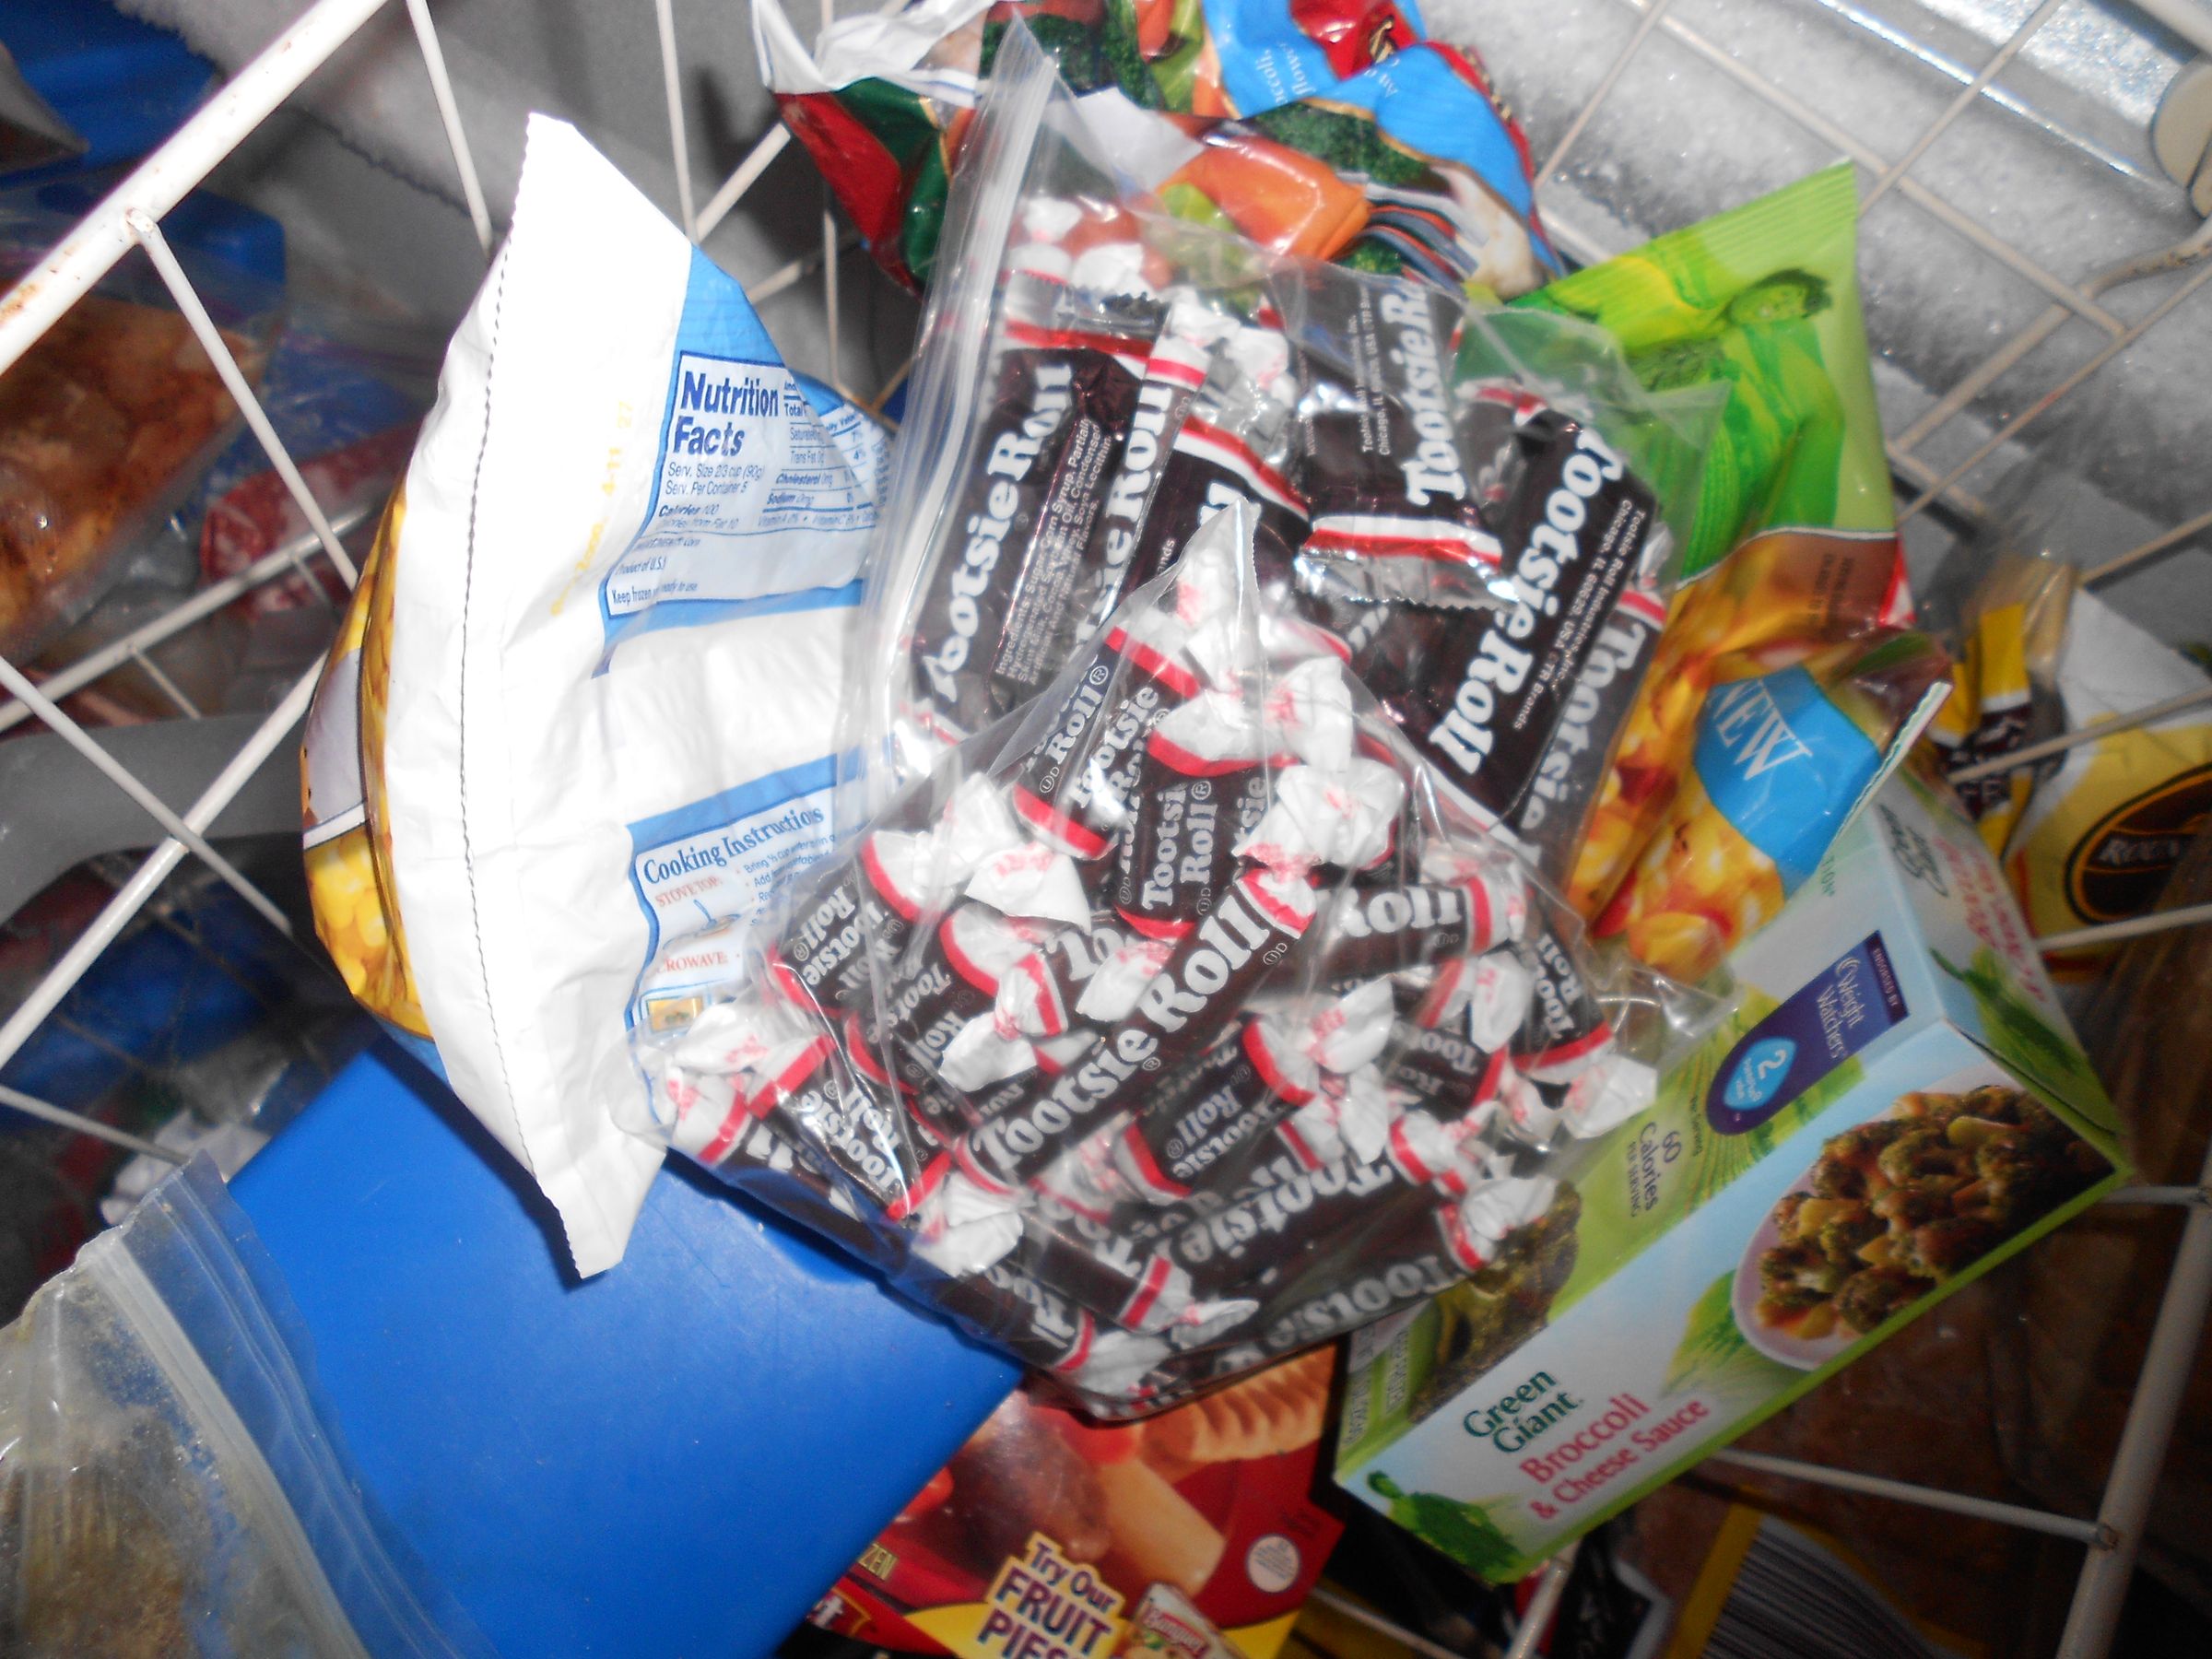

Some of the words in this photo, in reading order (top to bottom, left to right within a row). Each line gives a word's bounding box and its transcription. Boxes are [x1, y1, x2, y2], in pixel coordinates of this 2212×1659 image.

[680, 371, 779, 418] Nutrition
[1390, 330, 1465, 506] Tootsie
[673, 415, 745, 456] Facts
[1066, 422, 1105, 500] Condensed
[1106, 384, 1173, 522] Roll
[1373, 407, 1392, 455] Chicago,
[665, 479, 689, 495] Serv.
[691, 481, 706, 495] Per
[668, 462, 692, 477] Serv.
[697, 463, 713, 477] Size
[767, 492, 795, 505] Sodium
[776, 471, 821, 485] Cholesterol
[1050, 467, 1077, 514] Syrup,
[922, 480, 1019, 702] Tootsie
[987, 364, 1072, 481] Roll
[1497, 427, 1624, 640] Tootsie
[1596, 498, 1633, 556] Chicago,
[1616, 508, 1647, 558] Tootsie
[612, 589, 631, 606] Keep
[1045, 684, 1104, 765] Roll
[1429, 630, 1534, 776] Roll
[1512, 681, 1545, 732] Brands
[1520, 621, 1646, 830] Tootsie
[1717, 677, 1813, 780] NEW
[1069, 687, 1159, 808] Tootsie
[643, 843, 728, 885] Cooking
[1142, 783, 1187, 910] Tootsi
[1181, 801, 1219, 885] Roll
[806, 887, 856, 950] Roll
[1537, 933, 1584, 1005] Roll
[1838, 969, 1865, 1029] Weight
[973, 1025, 1159, 1172] Tootsie
[1143, 894, 1270, 1036] Roll
[1817, 984, 1842, 1058] Watchers
[1753, 1048, 1792, 1079] 2
[801, 1089, 900, 1192] Tootsie
[1176, 1084, 1243, 1148] Roll
[1662, 1130, 1681, 1163] 60
[1640, 1121, 1661, 1211] Calories
[1181, 1158, 1394, 1264] Tootsie
[1463, 1370, 1559, 1439] Green
[1491, 1390, 1578, 1455] Giant
[1518, 1392, 1653, 1486] Broccoli
[1528, 1497, 1559, 1521] &
[1552, 1445, 1641, 1504] Cheese
[1630, 1398, 1711, 1453] Sauce
[857, 1542, 900, 1583] ZEN
[1030, 1541, 1071, 1586] Try
[1069, 1570, 1116, 1614] Our
[994, 1567, 1112, 1656] FRUIT
